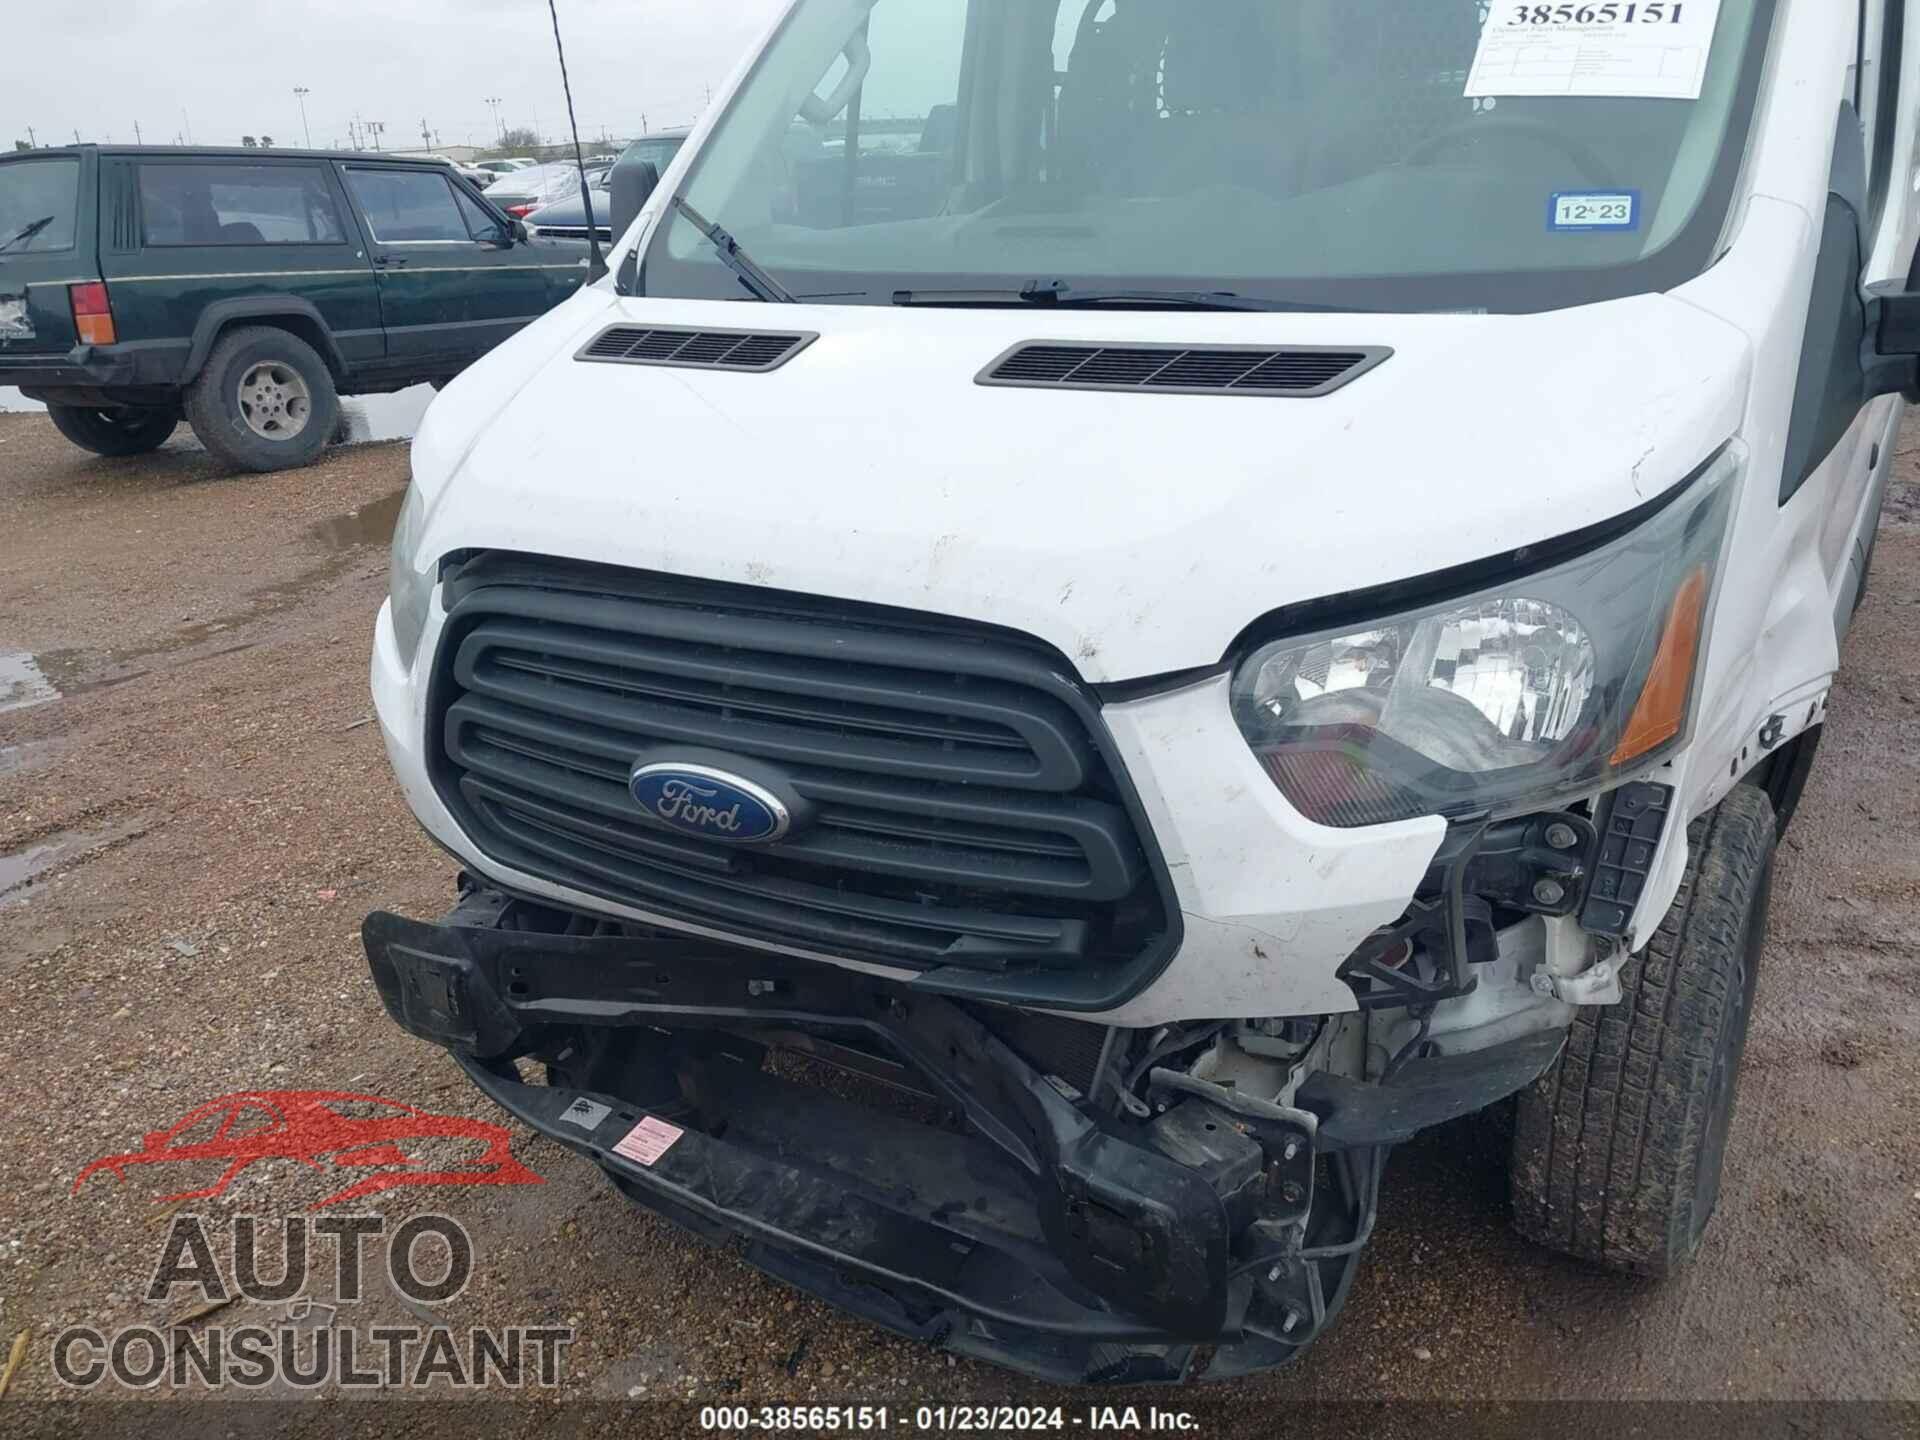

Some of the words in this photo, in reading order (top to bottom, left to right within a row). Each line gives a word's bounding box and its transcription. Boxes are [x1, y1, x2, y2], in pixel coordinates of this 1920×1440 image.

[1507, 3, 1683, 26] 38565151
[1561, 204, 1588, 220] 12
[1599, 204, 1628, 219] 23
[656, 779, 742, 831] Ford
